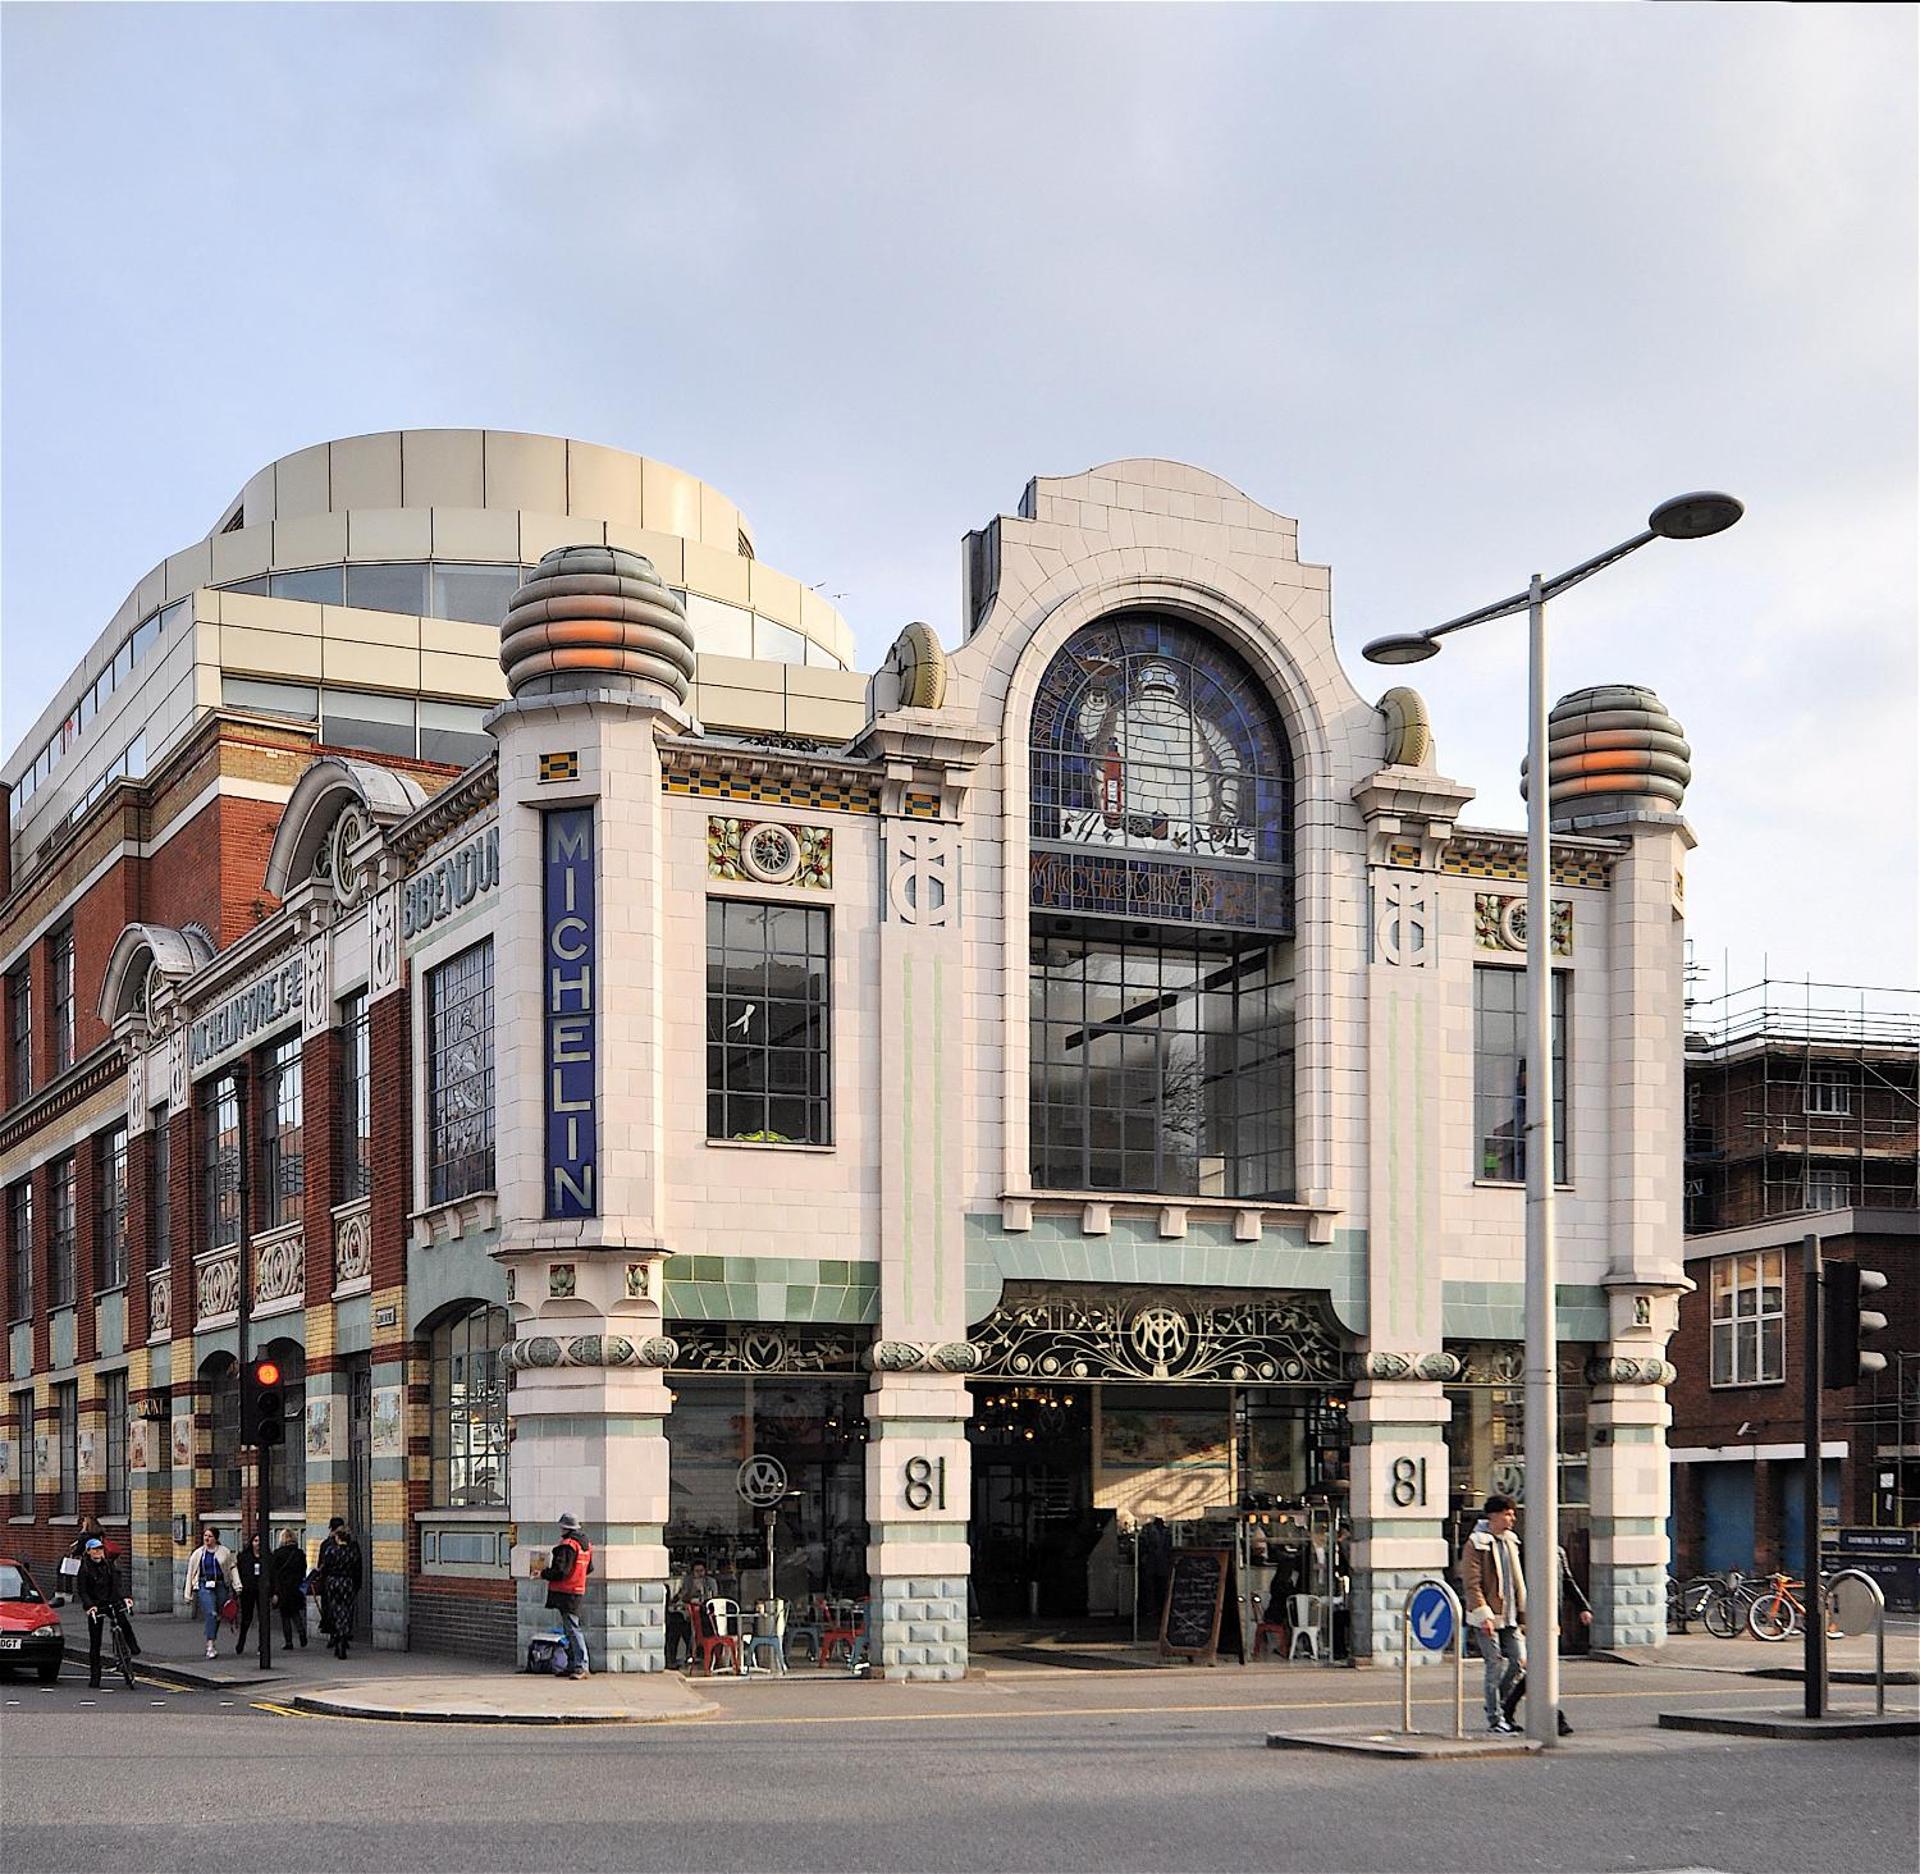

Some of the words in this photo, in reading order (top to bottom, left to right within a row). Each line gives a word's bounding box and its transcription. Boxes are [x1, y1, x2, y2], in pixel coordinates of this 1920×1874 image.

[551, 811, 592, 1211] MICHELIN
[905, 1455, 946, 1511] 81
[1392, 1456, 1427, 1508] 81
